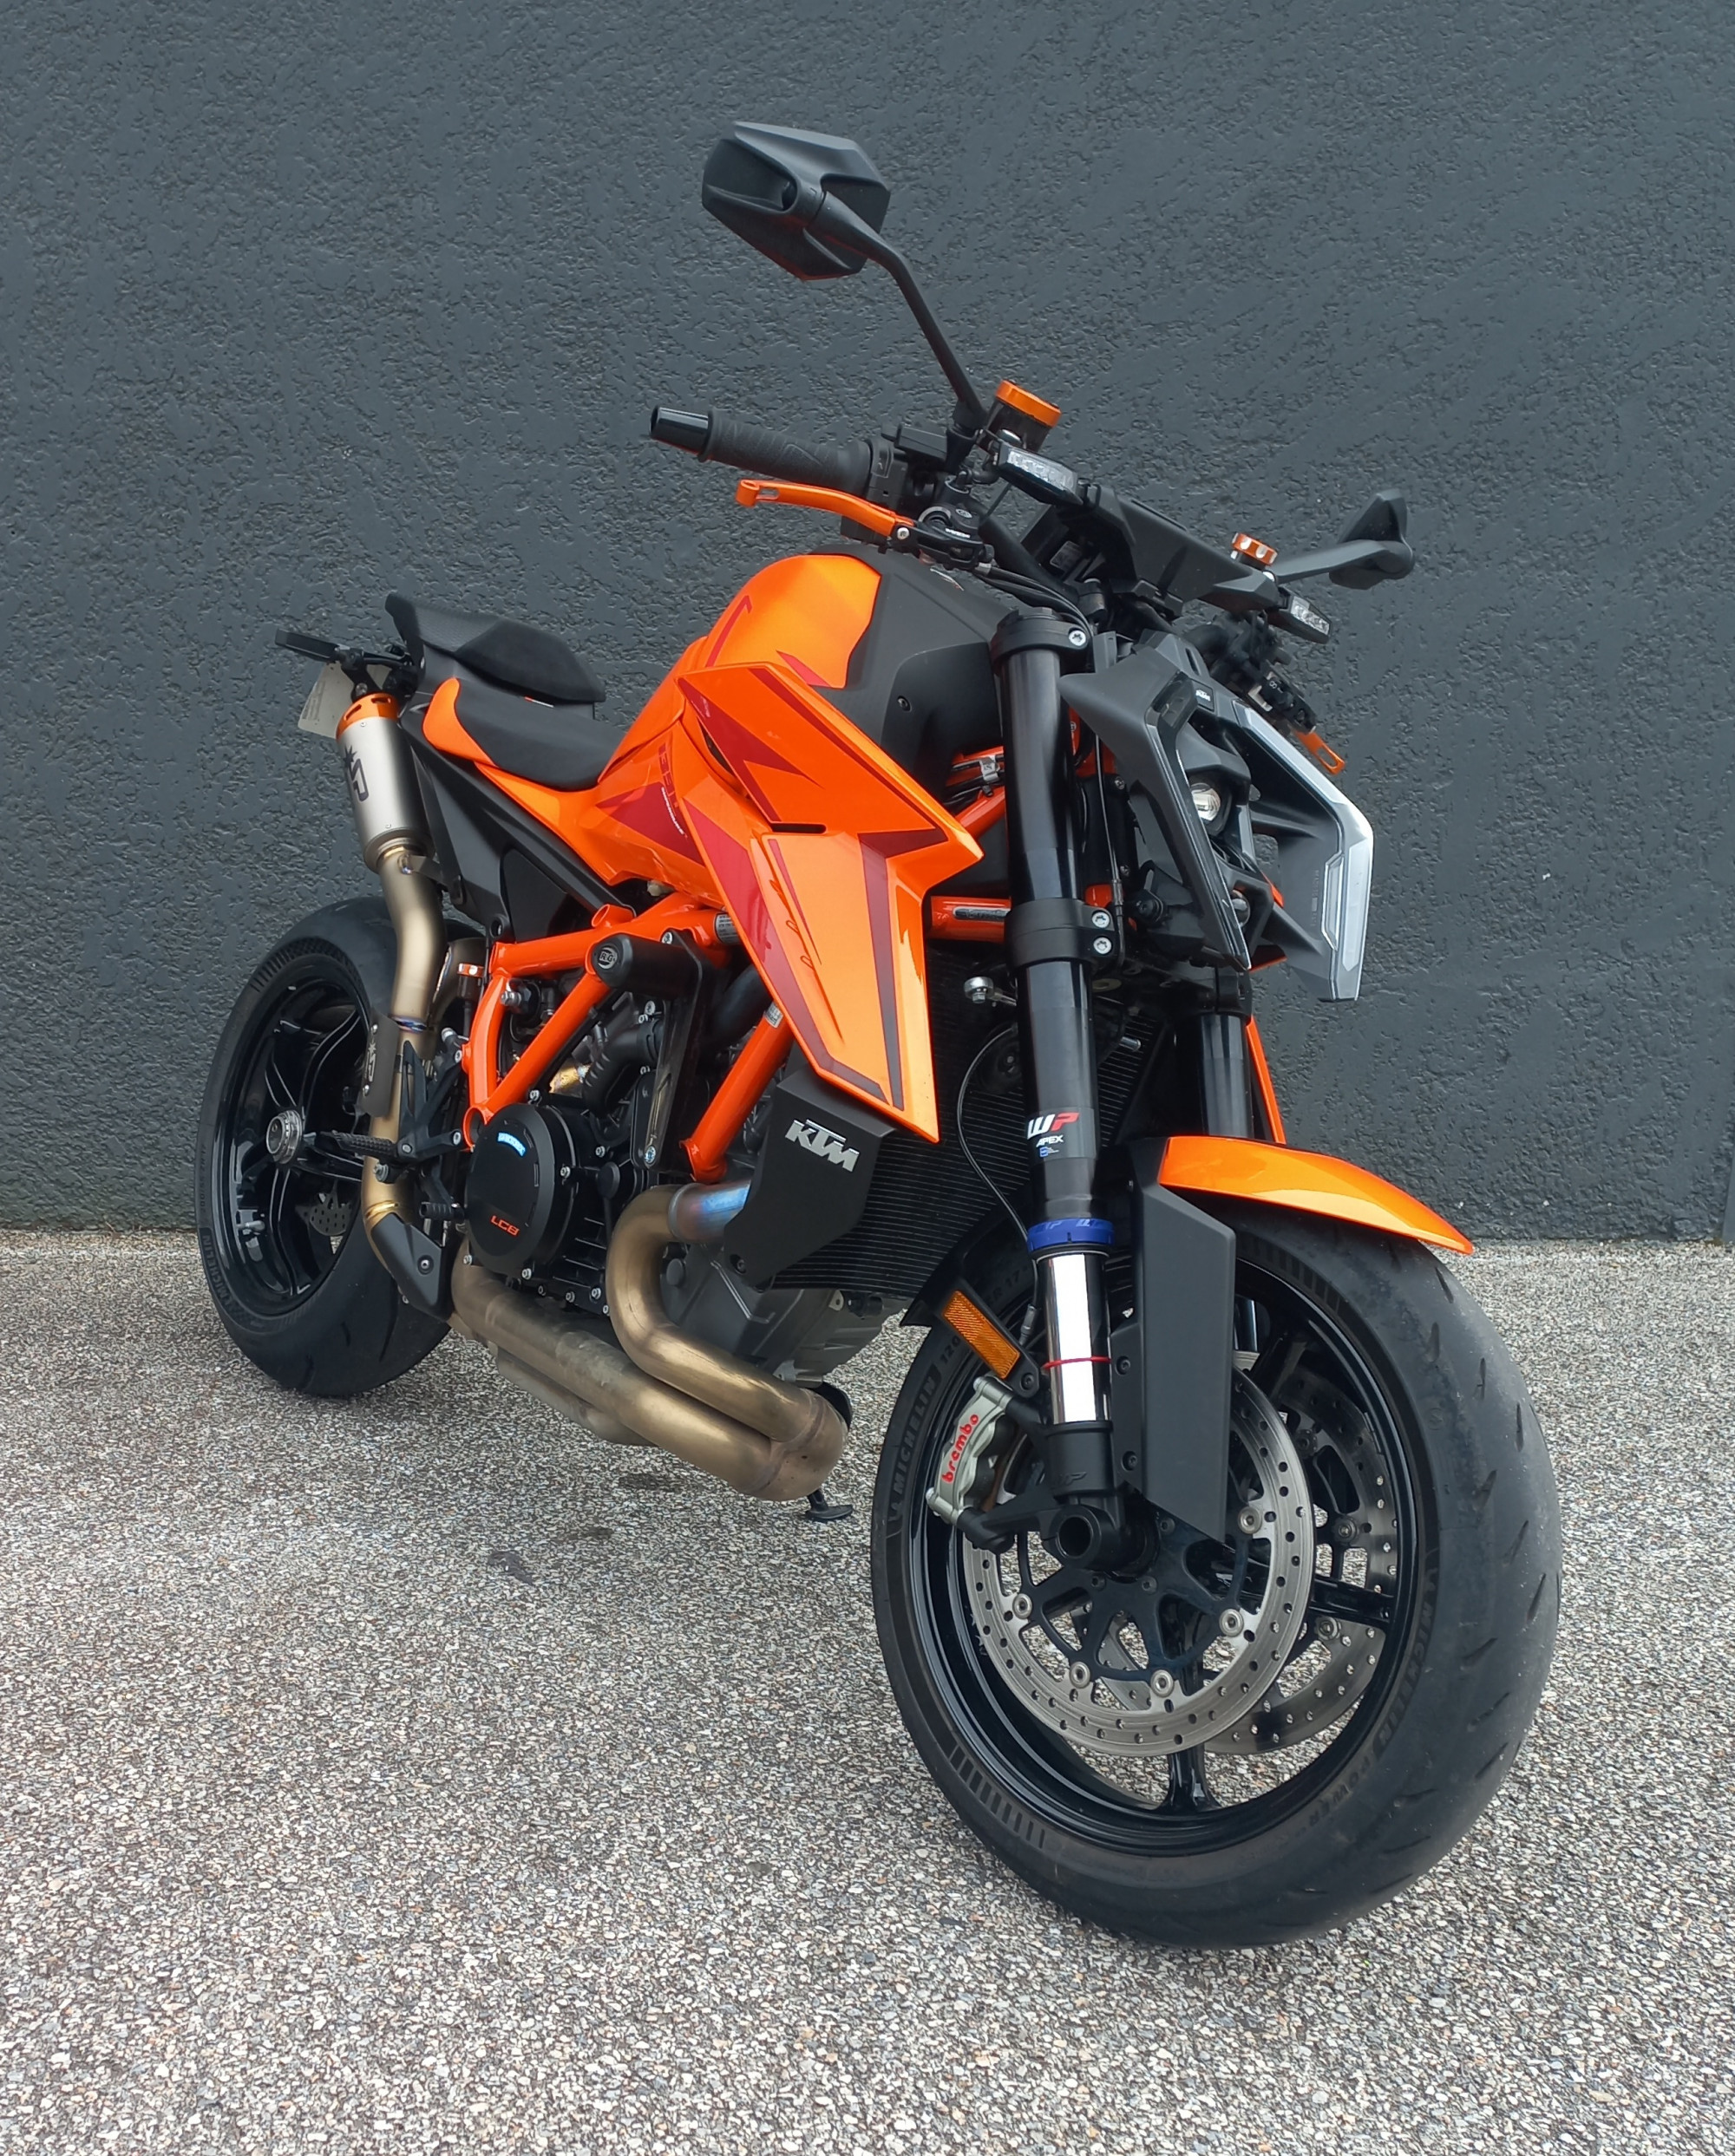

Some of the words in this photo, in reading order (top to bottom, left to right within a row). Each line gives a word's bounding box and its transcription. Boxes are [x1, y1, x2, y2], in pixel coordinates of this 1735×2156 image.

[785, 1119, 860, 1172] KTM
[1027, 1112, 1079, 1140] WP
[1036, 1134, 1064, 1147] APEX
[490, 1215, 520, 1236] LC8
[202, 1235, 229, 1298] MICHELIN
[893, 1375, 936, 1495] MICHELIN
[941, 1414, 979, 1484] brembo
